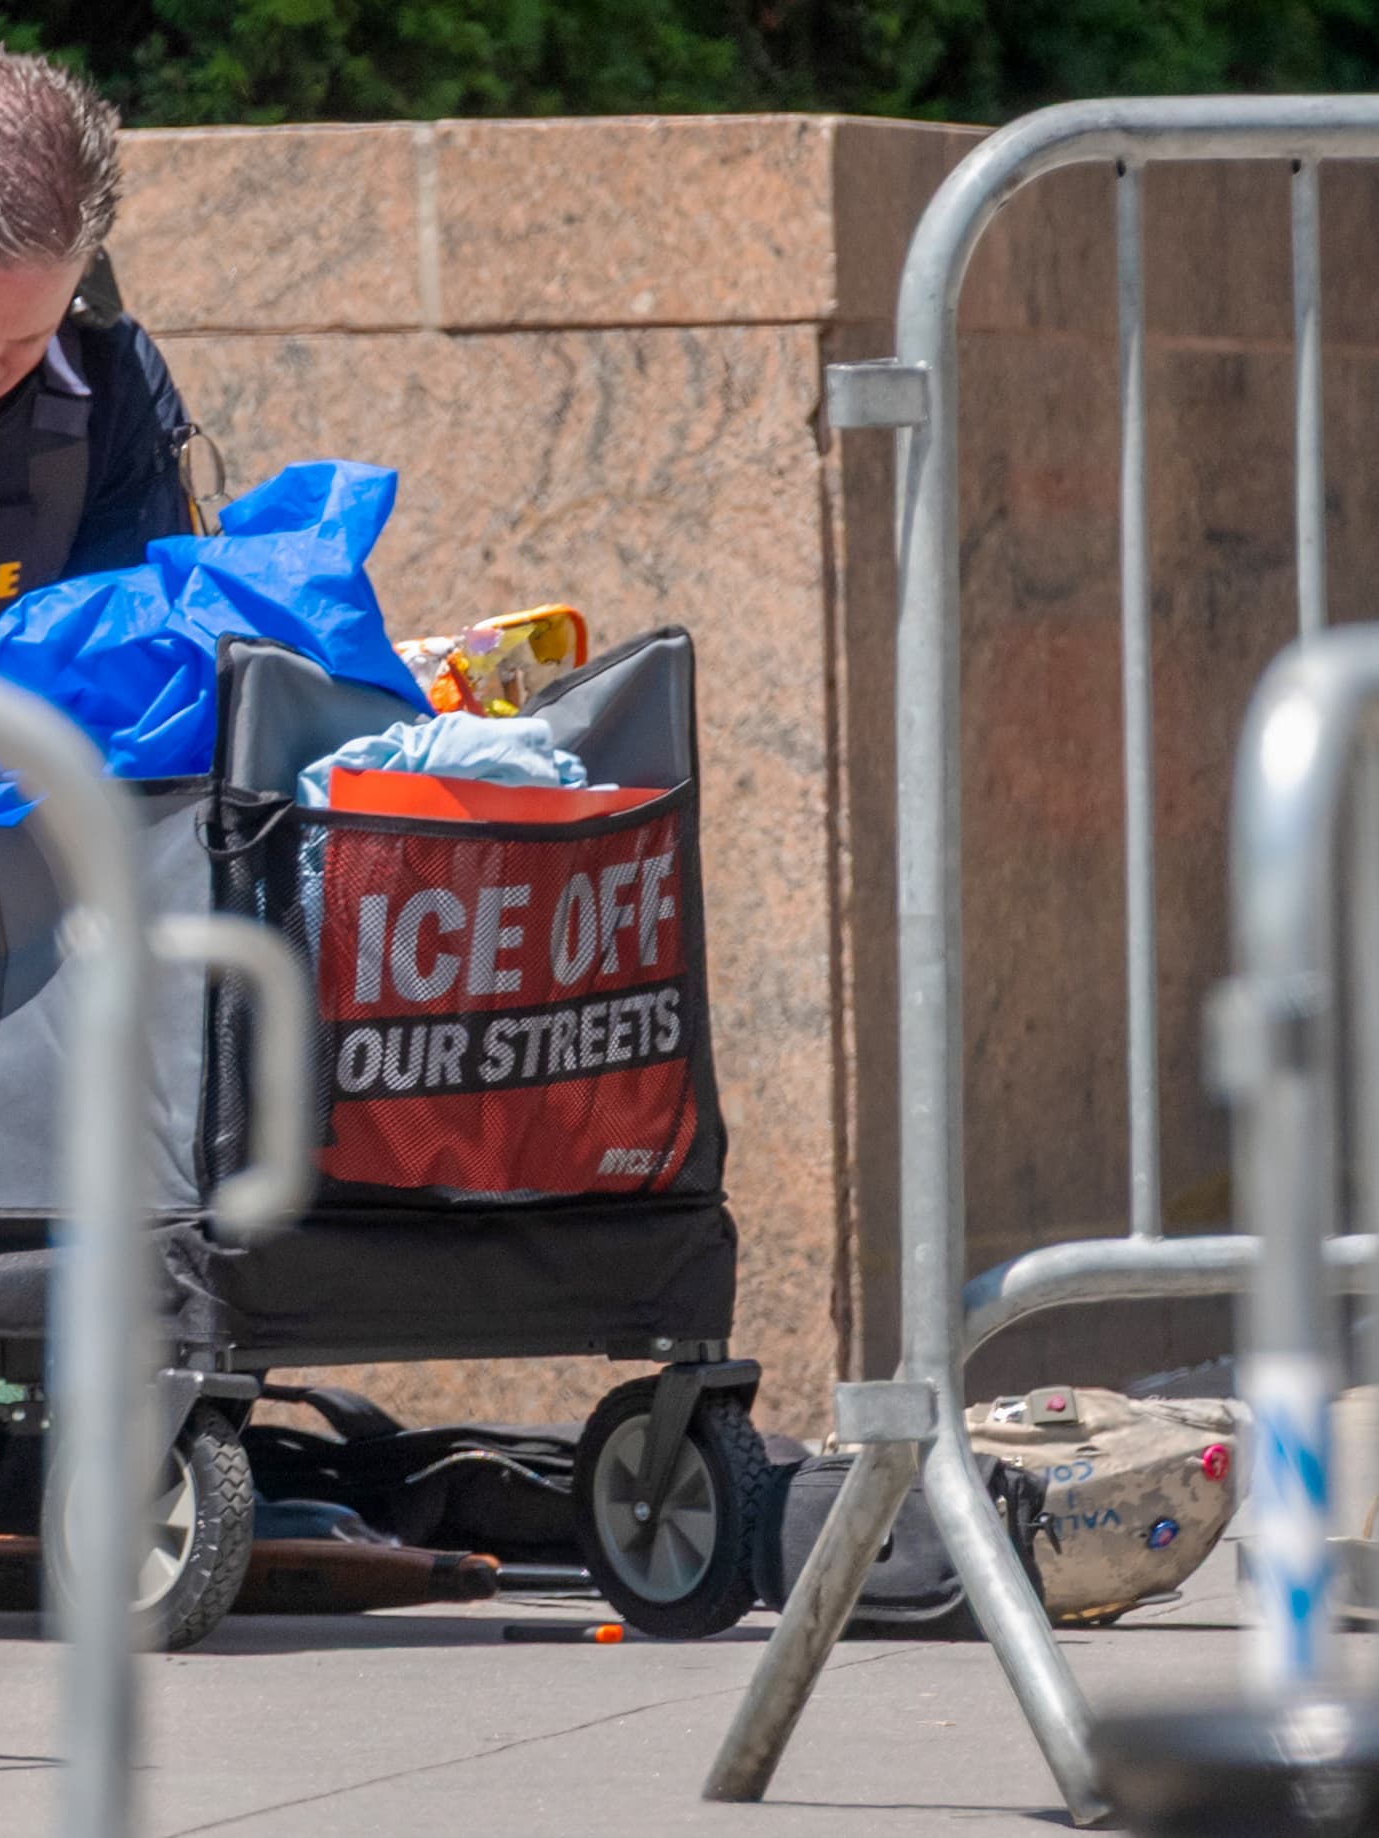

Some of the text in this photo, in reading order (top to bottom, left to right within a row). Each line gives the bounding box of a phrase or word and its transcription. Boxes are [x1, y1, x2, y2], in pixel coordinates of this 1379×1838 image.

[353, 851, 676, 1004] ICE OFF
[335, 987, 681, 1093] OUR STREETS
